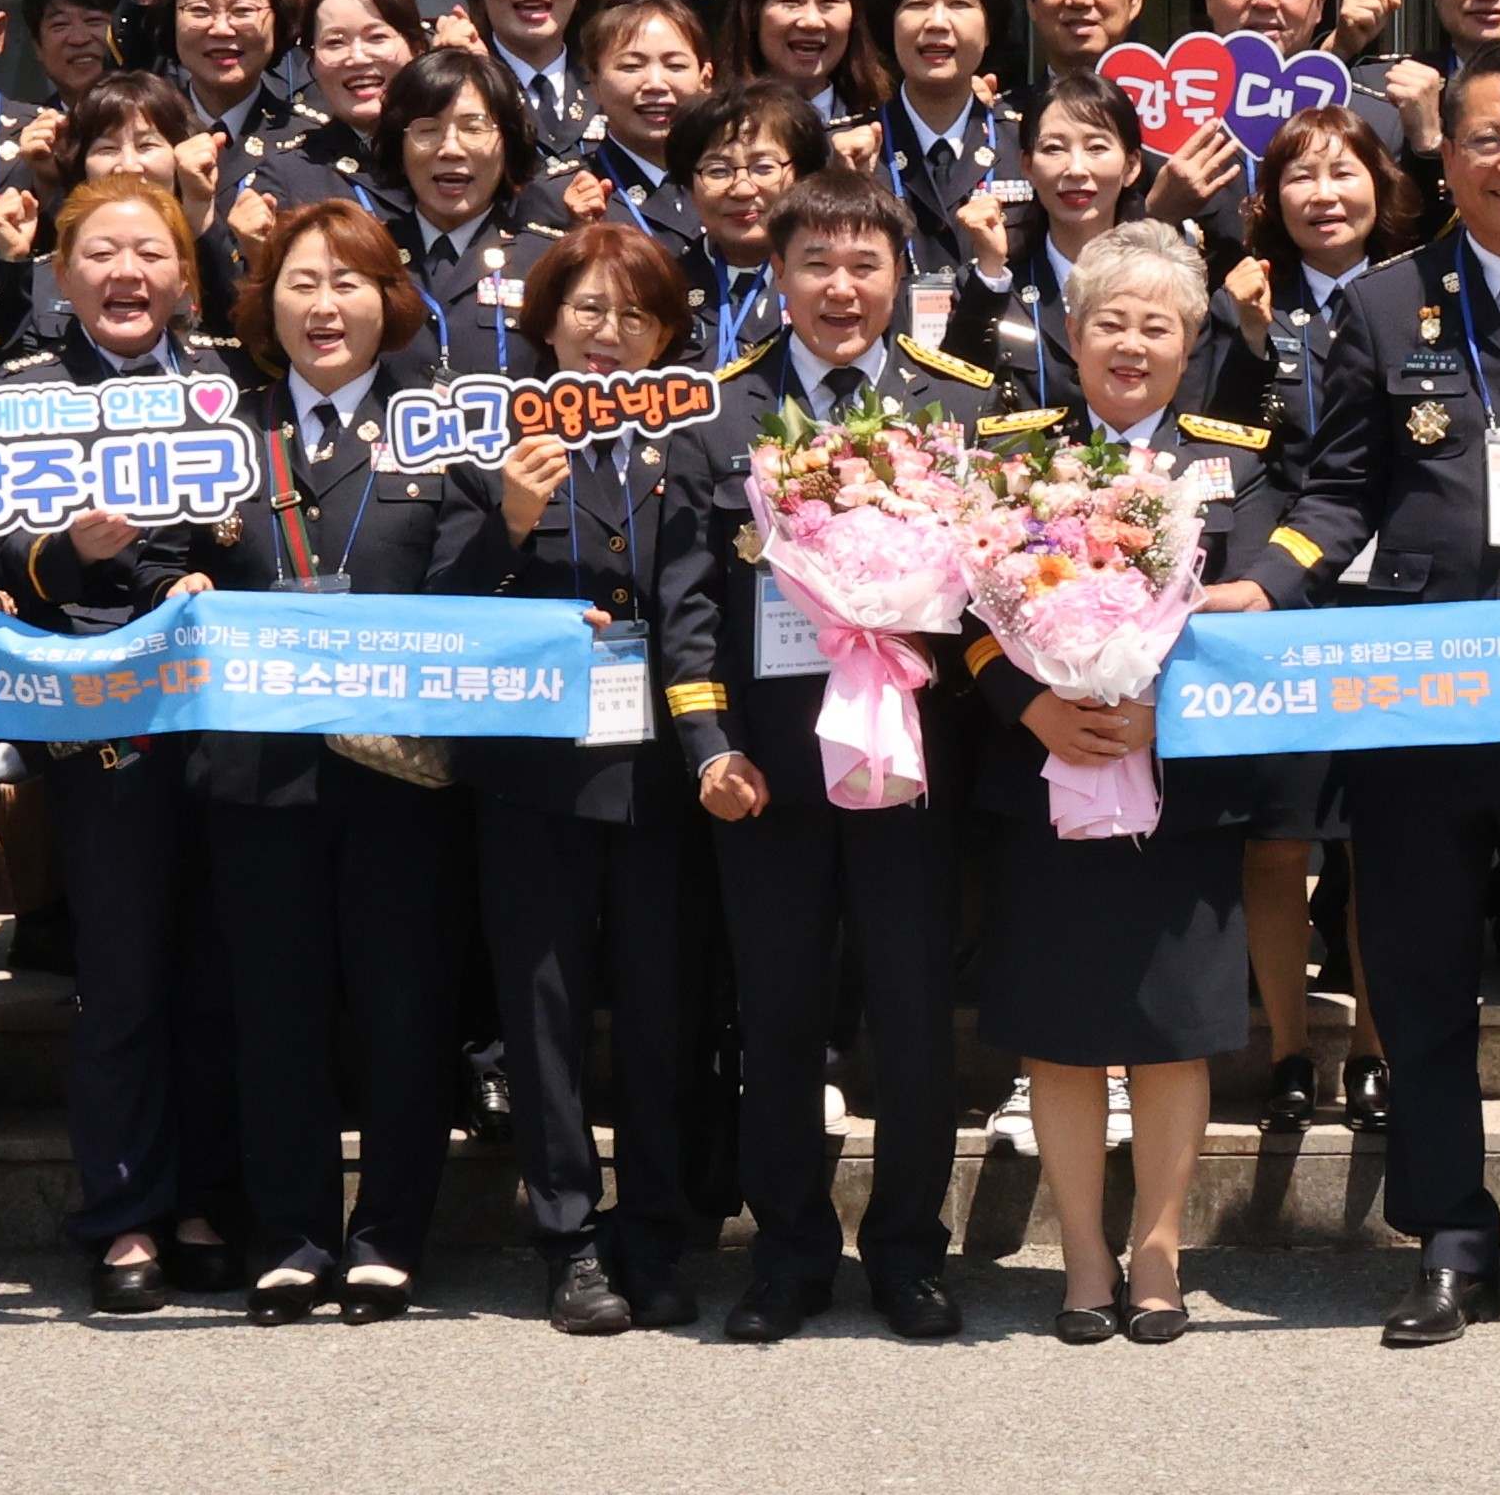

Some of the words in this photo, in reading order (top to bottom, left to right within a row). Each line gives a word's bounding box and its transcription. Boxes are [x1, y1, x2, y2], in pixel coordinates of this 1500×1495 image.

[107, 382, 180, 424] 안전
[401, 392, 509, 457] 대구
[513, 379, 708, 437] 의용소방대
[174, 625, 250, 648] 이어가는
[358, 631, 464, 652] 안전지킴이
[1282, 646, 1344, 666] 소통과
[1351, 641, 1433, 662] 화합으로
[74, 659, 211, 707] 광주-대구
[224, 660, 406, 698] 의용소방대
[419, 667, 564, 702] 교류행사
[1180, 679, 1317, 718] 2026년
[1330, 671, 1491, 713] 광주-대구
